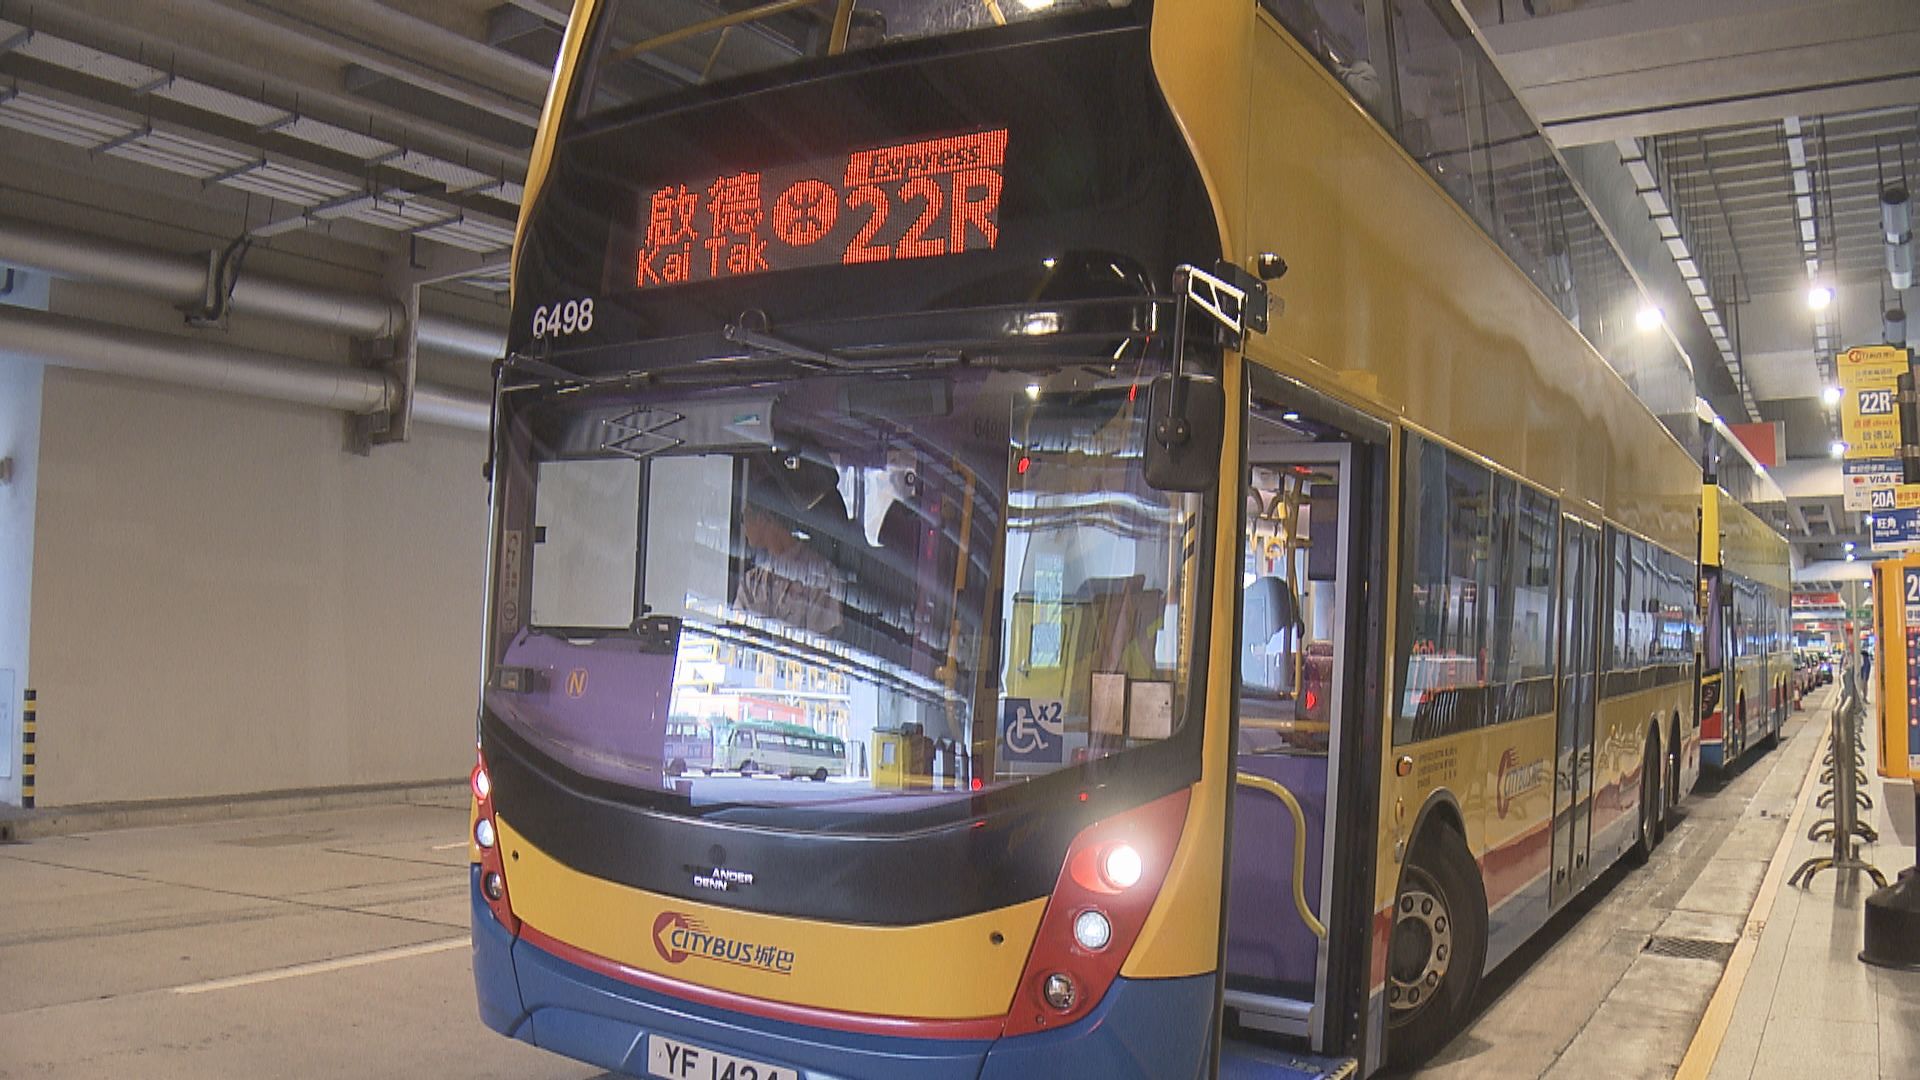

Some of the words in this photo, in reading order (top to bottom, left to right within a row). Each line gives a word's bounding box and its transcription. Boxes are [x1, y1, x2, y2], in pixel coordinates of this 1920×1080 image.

[870, 146, 979, 178] Express
[843, 169, 1004, 265] 22R
[636, 240, 691, 288] Kai
[705, 233, 769, 276] Tak
[532, 298, 594, 337] 6498
[1860, 392, 1891, 413] 22R
[1869, 475, 1891, 483] VISA
[1872, 491, 1895, 507] 20A
[1038, 702, 1061, 723] x2
[671, 928, 753, 963] CITYBUS
[754, 944, 795, 972] 城巴
[665, 1042, 698, 1077] YF
